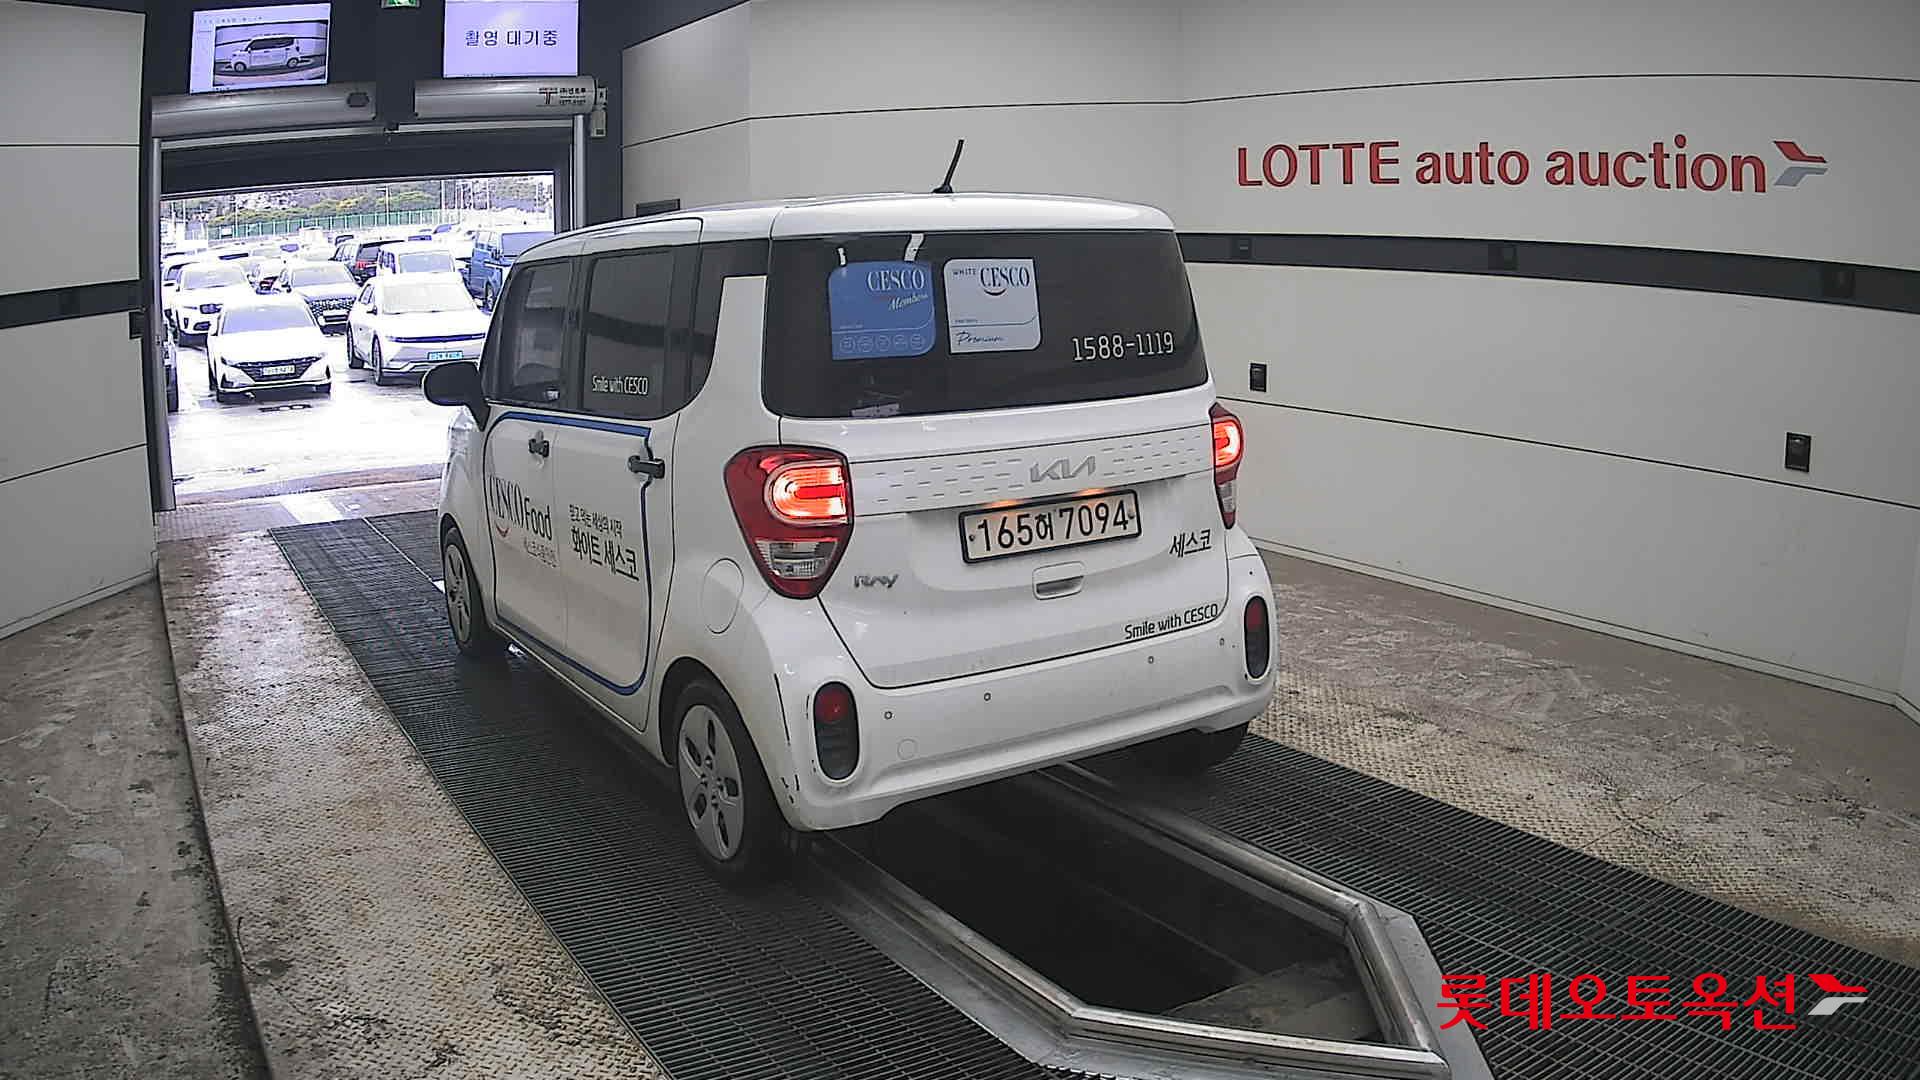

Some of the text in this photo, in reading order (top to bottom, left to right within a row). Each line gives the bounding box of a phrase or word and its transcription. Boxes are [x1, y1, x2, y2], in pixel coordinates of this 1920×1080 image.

[465, 29, 558, 46] 촬영 대기중
[1238, 134, 1766, 193] LOTTE auto auction
[867, 269, 925, 291] CESCO
[980, 266, 1030, 287] CESCO
[1072, 331, 1174, 361] 1588-1119
[624, 376, 648, 395] CESCO
[1030, 456, 1096, 483] KIA
[524, 497, 552, 541] Food
[981, 500, 1129, 552] 165허 7094
[571, 525, 602, 566] 화이트
[604, 540, 640, 581] 세스코
[1169, 529, 1212, 558] 세스코
[1124, 603, 1218, 640] Smile with CESCO
